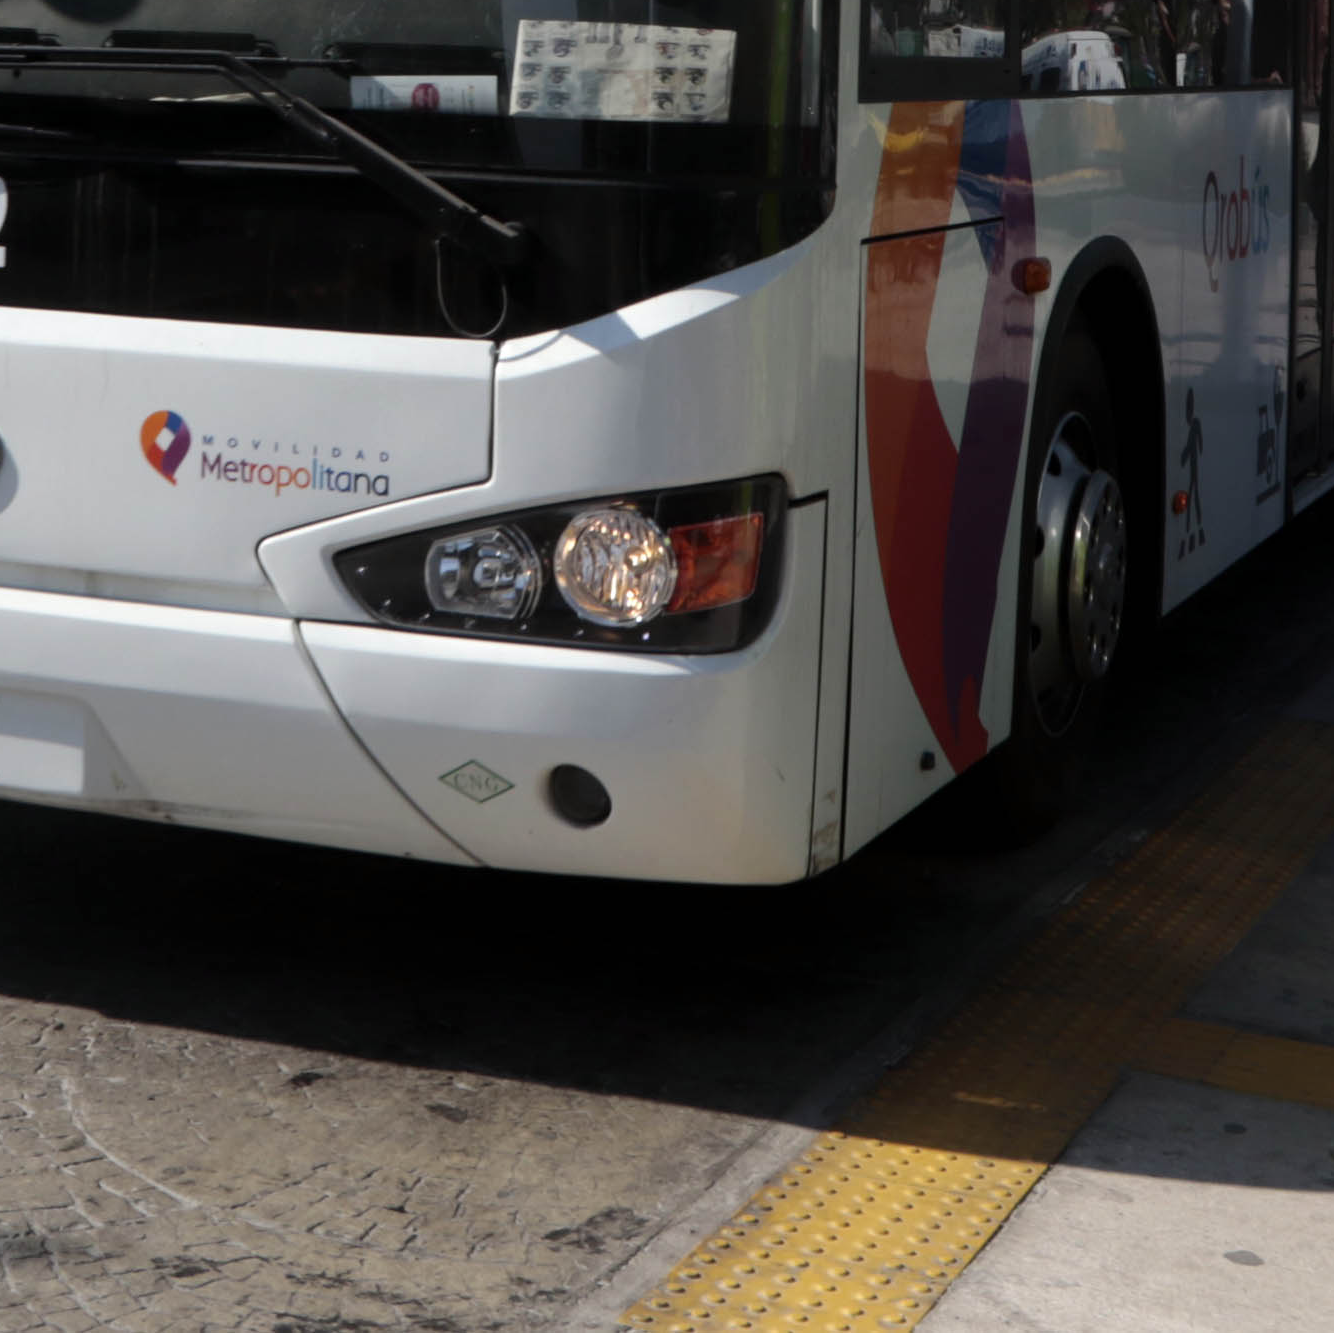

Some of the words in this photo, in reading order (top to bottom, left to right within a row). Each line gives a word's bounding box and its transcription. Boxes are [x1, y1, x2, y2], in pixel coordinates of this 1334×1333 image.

[201, 434, 390, 463] MOVILIDAD
[200, 451, 390, 497] Metropolitana
[453, 773, 499, 792] CNG
